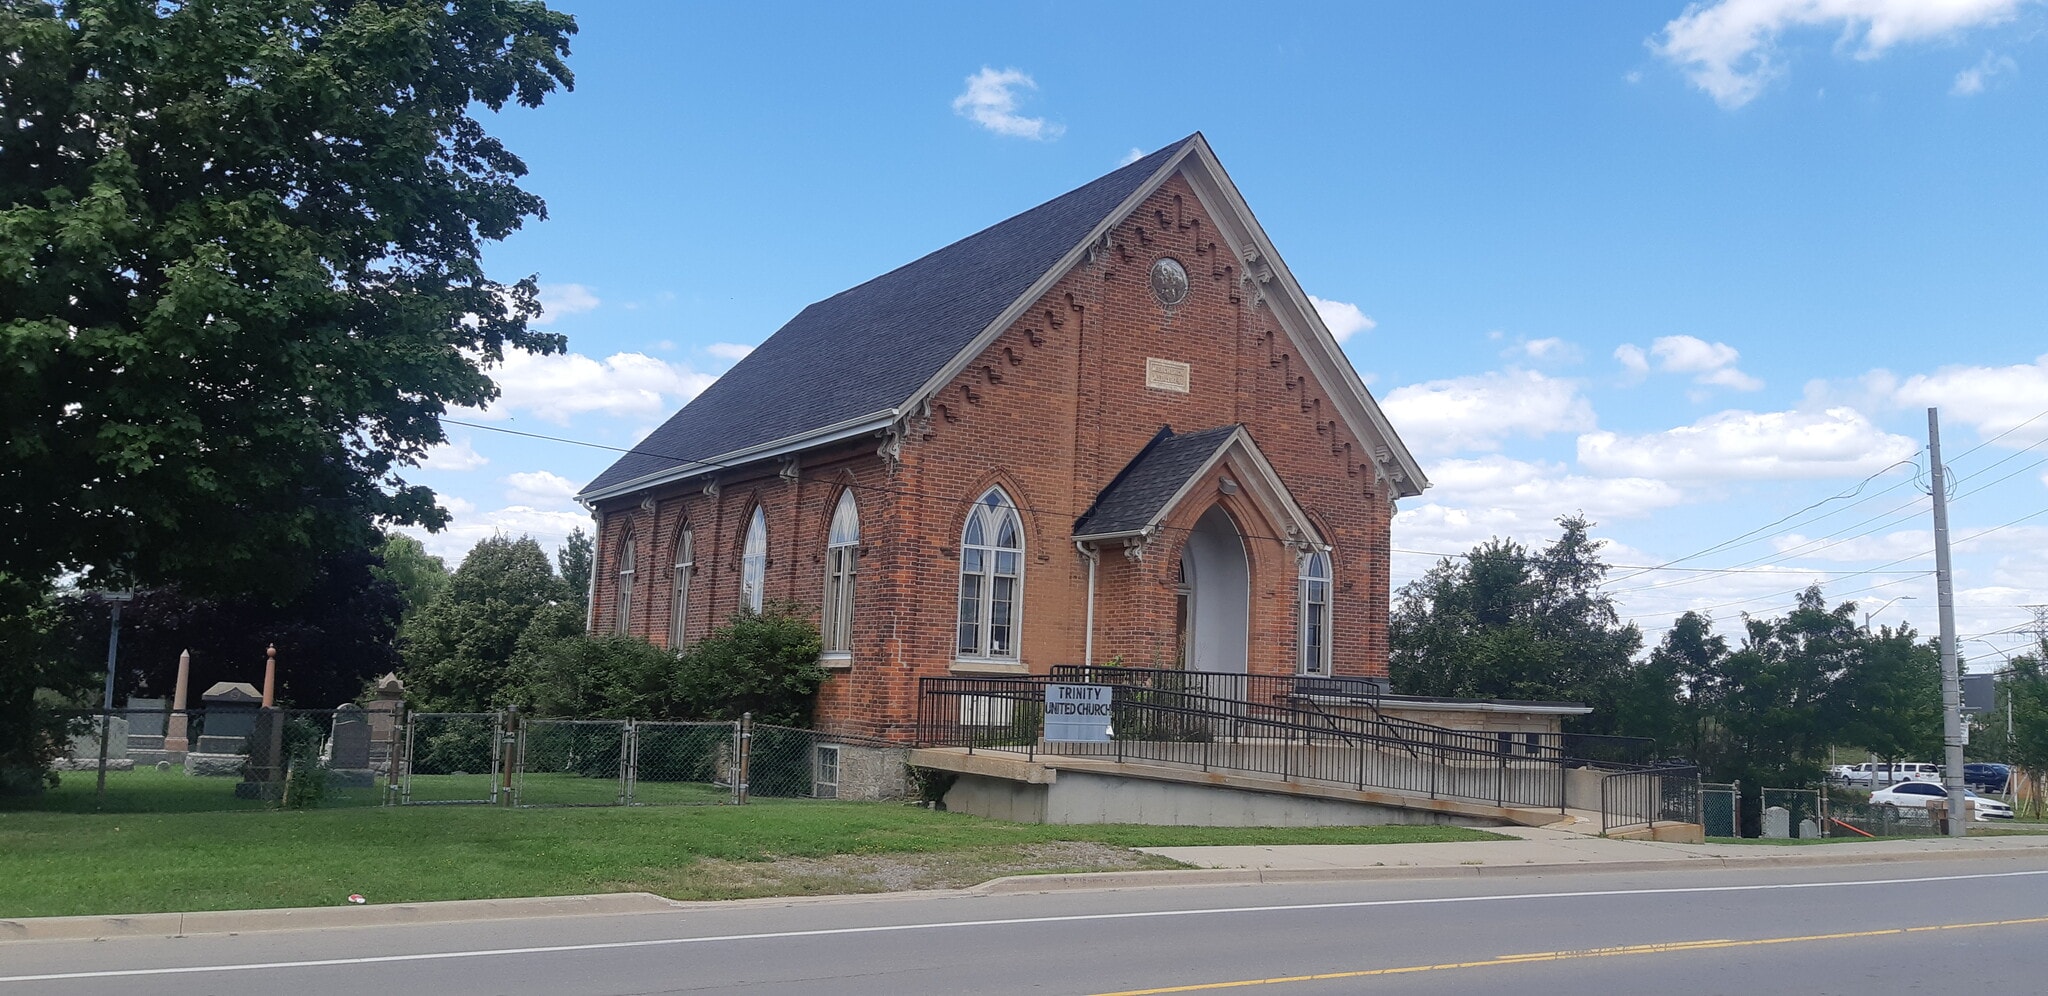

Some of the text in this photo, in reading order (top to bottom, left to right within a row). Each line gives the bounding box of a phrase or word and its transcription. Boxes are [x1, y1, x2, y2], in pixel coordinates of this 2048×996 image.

[1058, 687, 1102, 700] TRINITY
[1046, 702, 1112, 716] UNITED CHURCH
